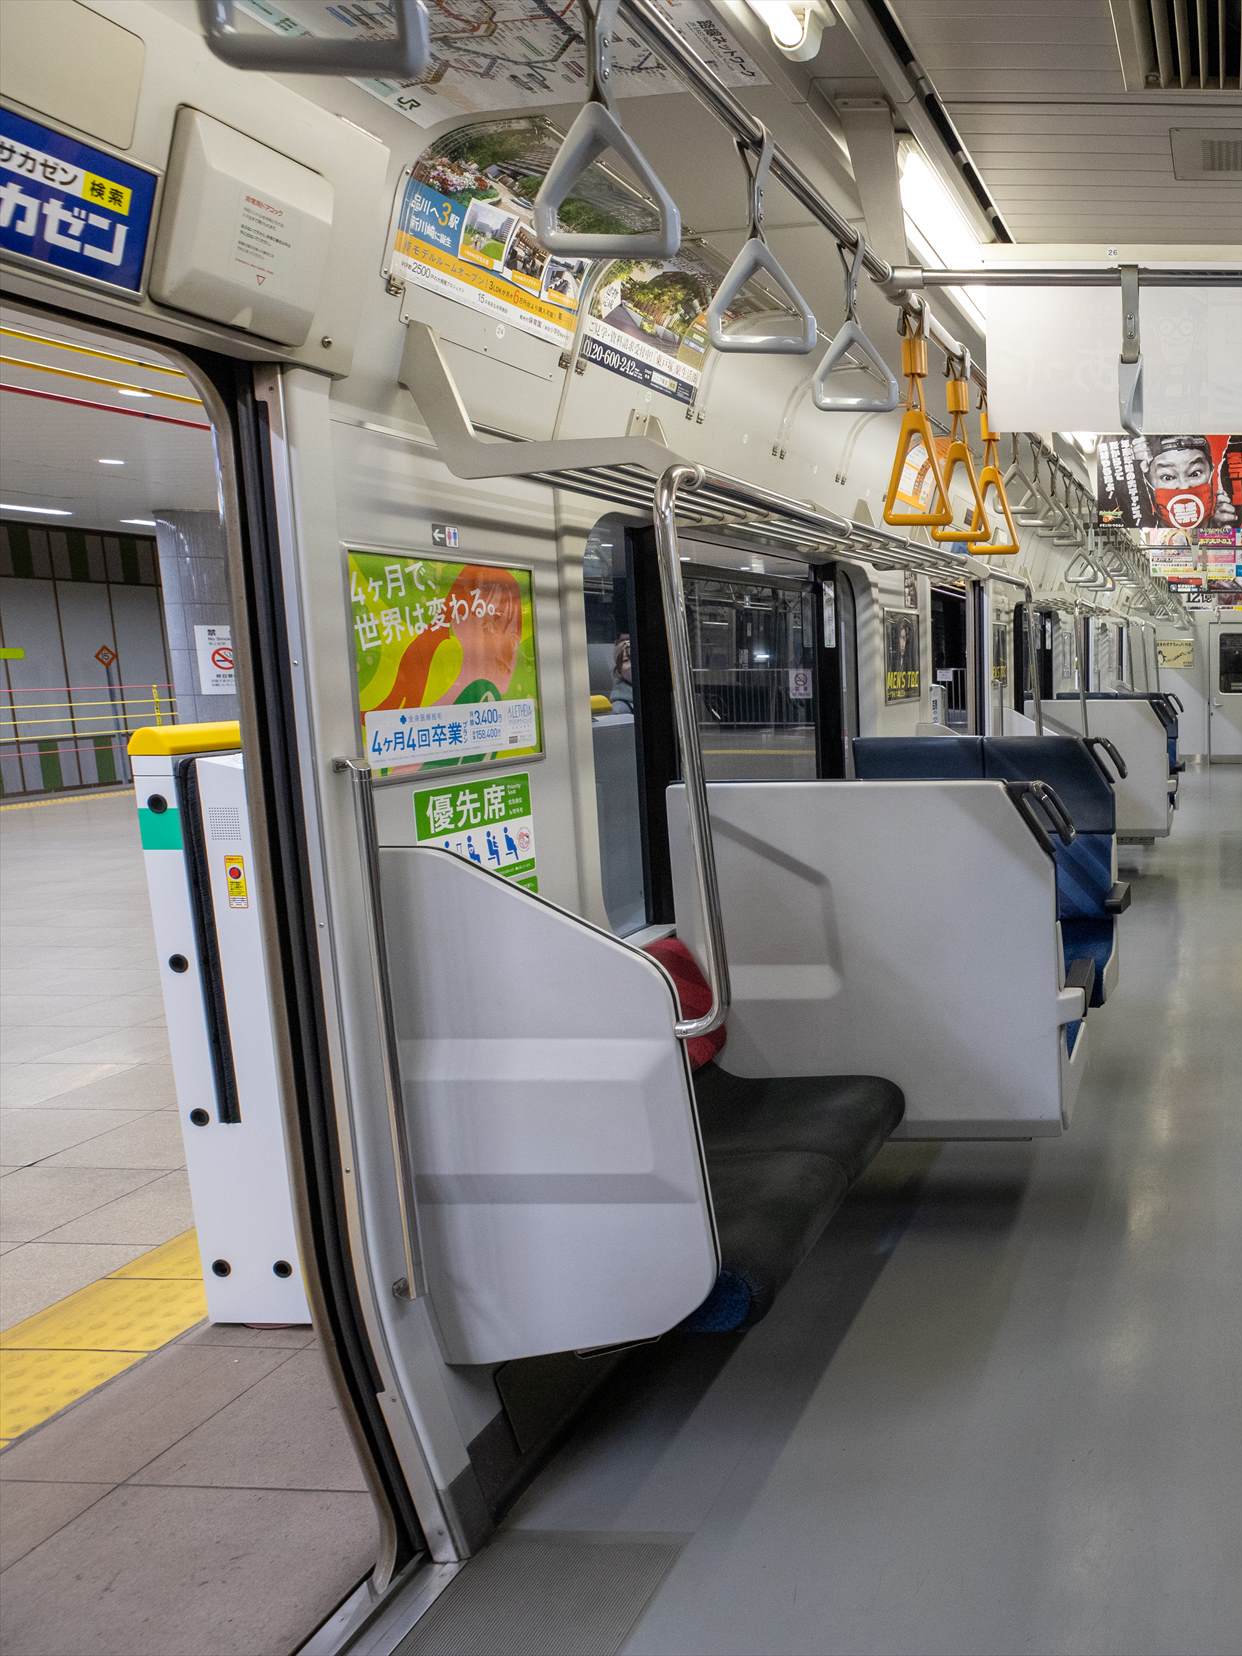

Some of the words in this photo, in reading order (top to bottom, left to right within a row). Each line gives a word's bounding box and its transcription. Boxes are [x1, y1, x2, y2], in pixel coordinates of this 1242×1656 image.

[0, 141, 78, 186] サカゼン
[90, 180, 125, 207] 検索
[354, 589, 496, 651] 世界は変わる。
[426, 784, 506, 834] 優先席
